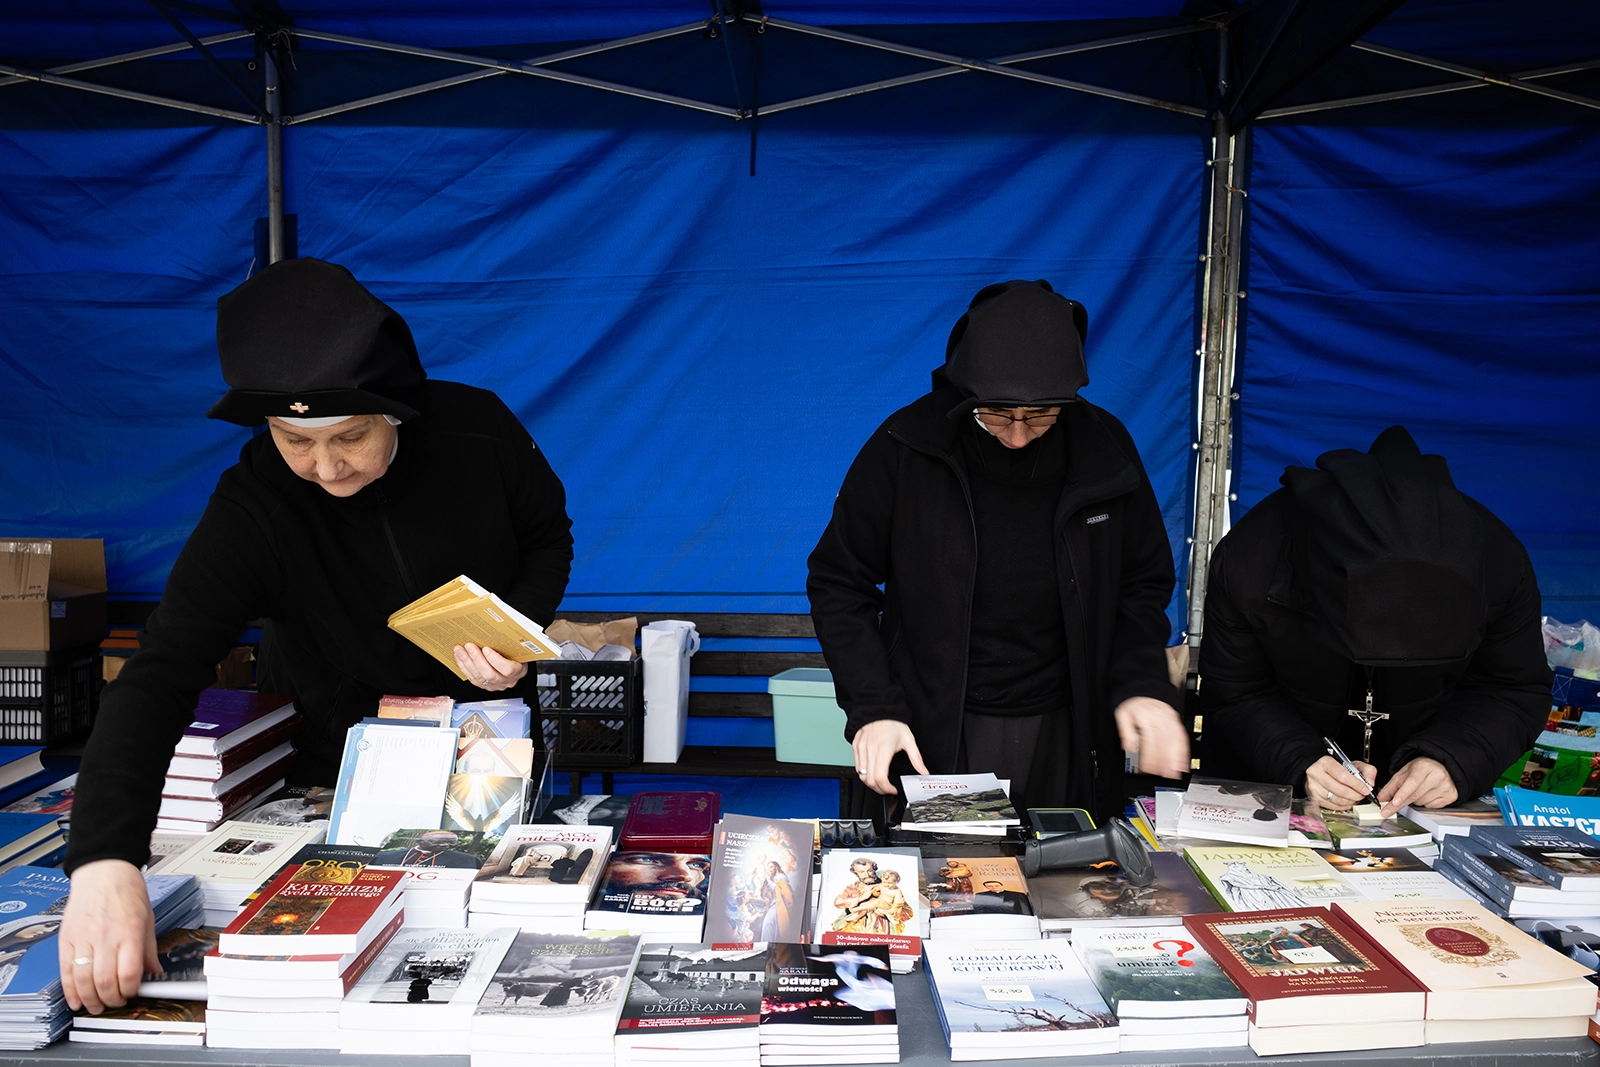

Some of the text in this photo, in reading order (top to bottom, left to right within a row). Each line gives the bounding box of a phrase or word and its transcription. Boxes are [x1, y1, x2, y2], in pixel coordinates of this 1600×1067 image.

[1534, 804, 1571, 815] Anatol
[728, 832, 765, 841] UCIECZKA
[726, 839, 751, 848] NASZA
[1520, 840, 1596, 849] JEZUSA
[1203, 852, 1308, 860] JADWIGA
[287, 883, 386, 893] KATECHIZM
[1375, 909, 1465, 918] Niespokojne
[1374, 915, 1400, 924] jest
[1445, 913, 1480, 921] moje
[530, 948, 615, 956] SZCZĘŚCIE
[952, 964, 1064, 972] KULTUROWEJ
[1269, 966, 1365, 977] JADWIGA
[778, 977, 838, 986] Odwaga
[643, 1003, 747, 1013] UMIERANIA
